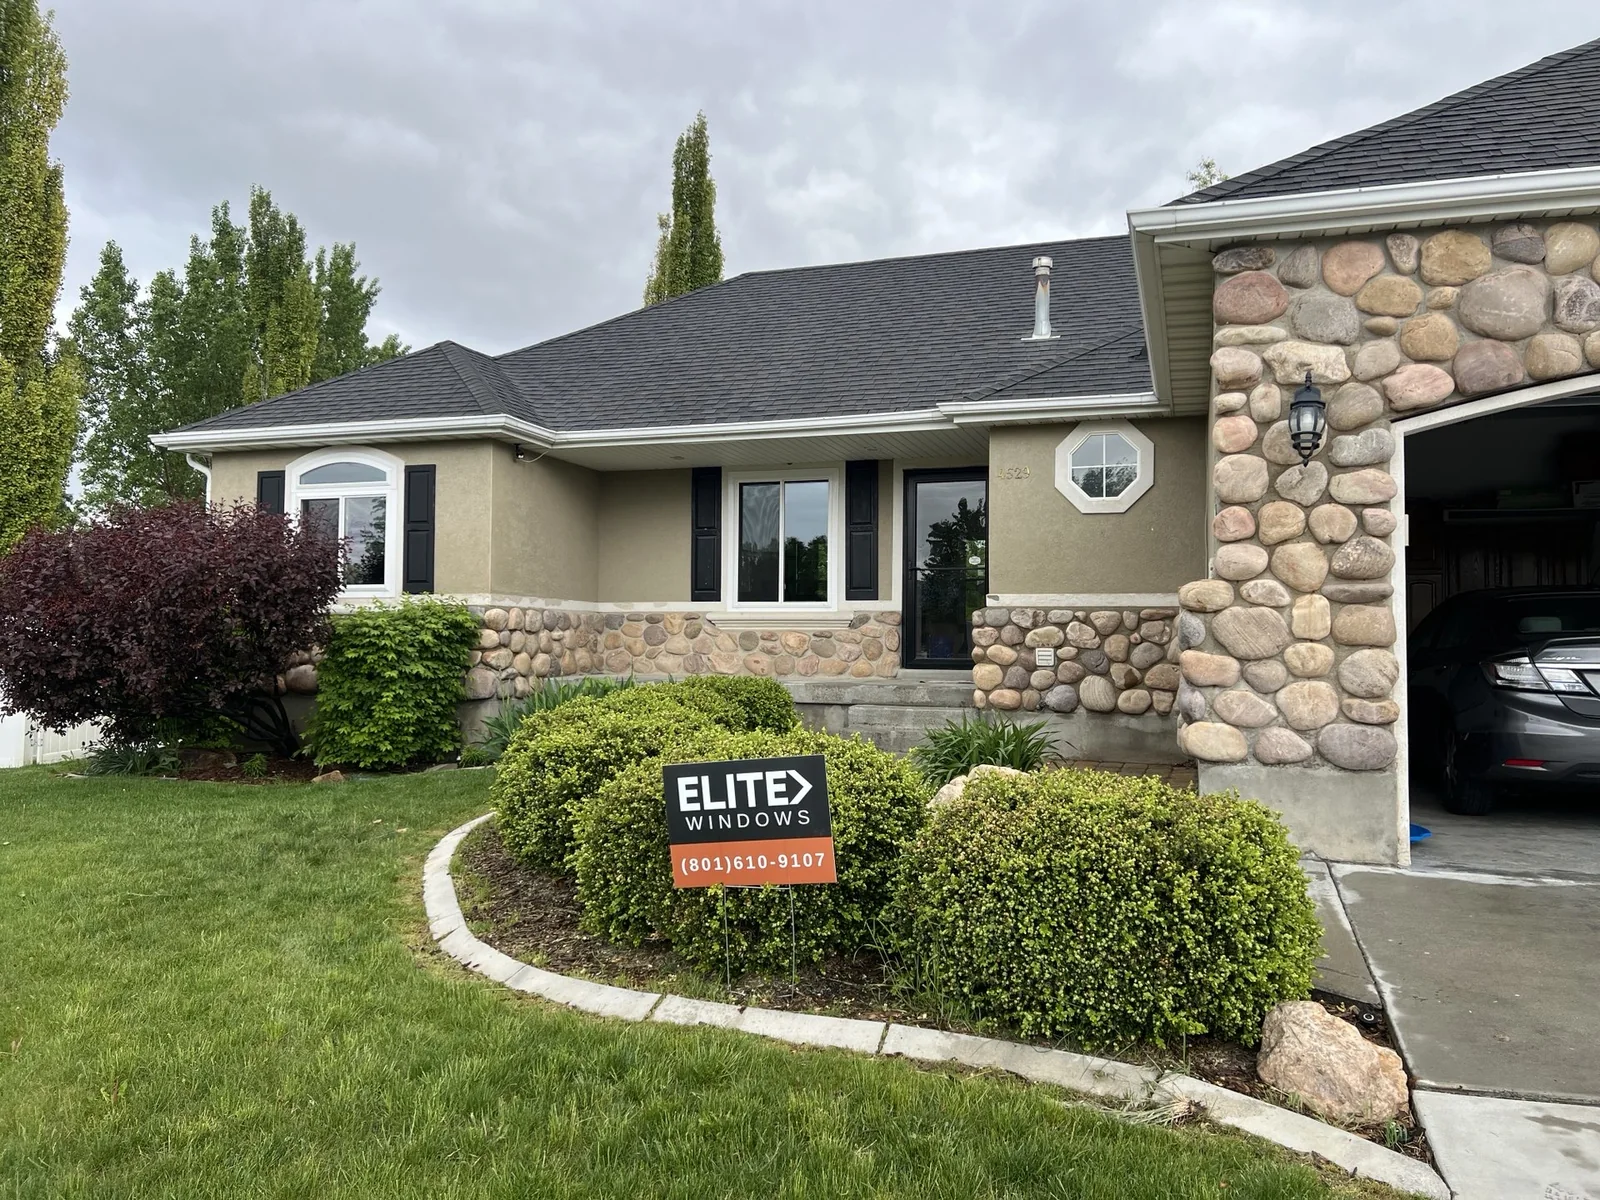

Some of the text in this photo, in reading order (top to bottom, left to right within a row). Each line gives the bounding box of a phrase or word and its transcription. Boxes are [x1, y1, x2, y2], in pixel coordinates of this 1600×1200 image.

[677, 770, 789, 812] ELITE
[685, 810, 811, 831] WINDOWS
[681, 853, 825, 875] (801)610-9107
